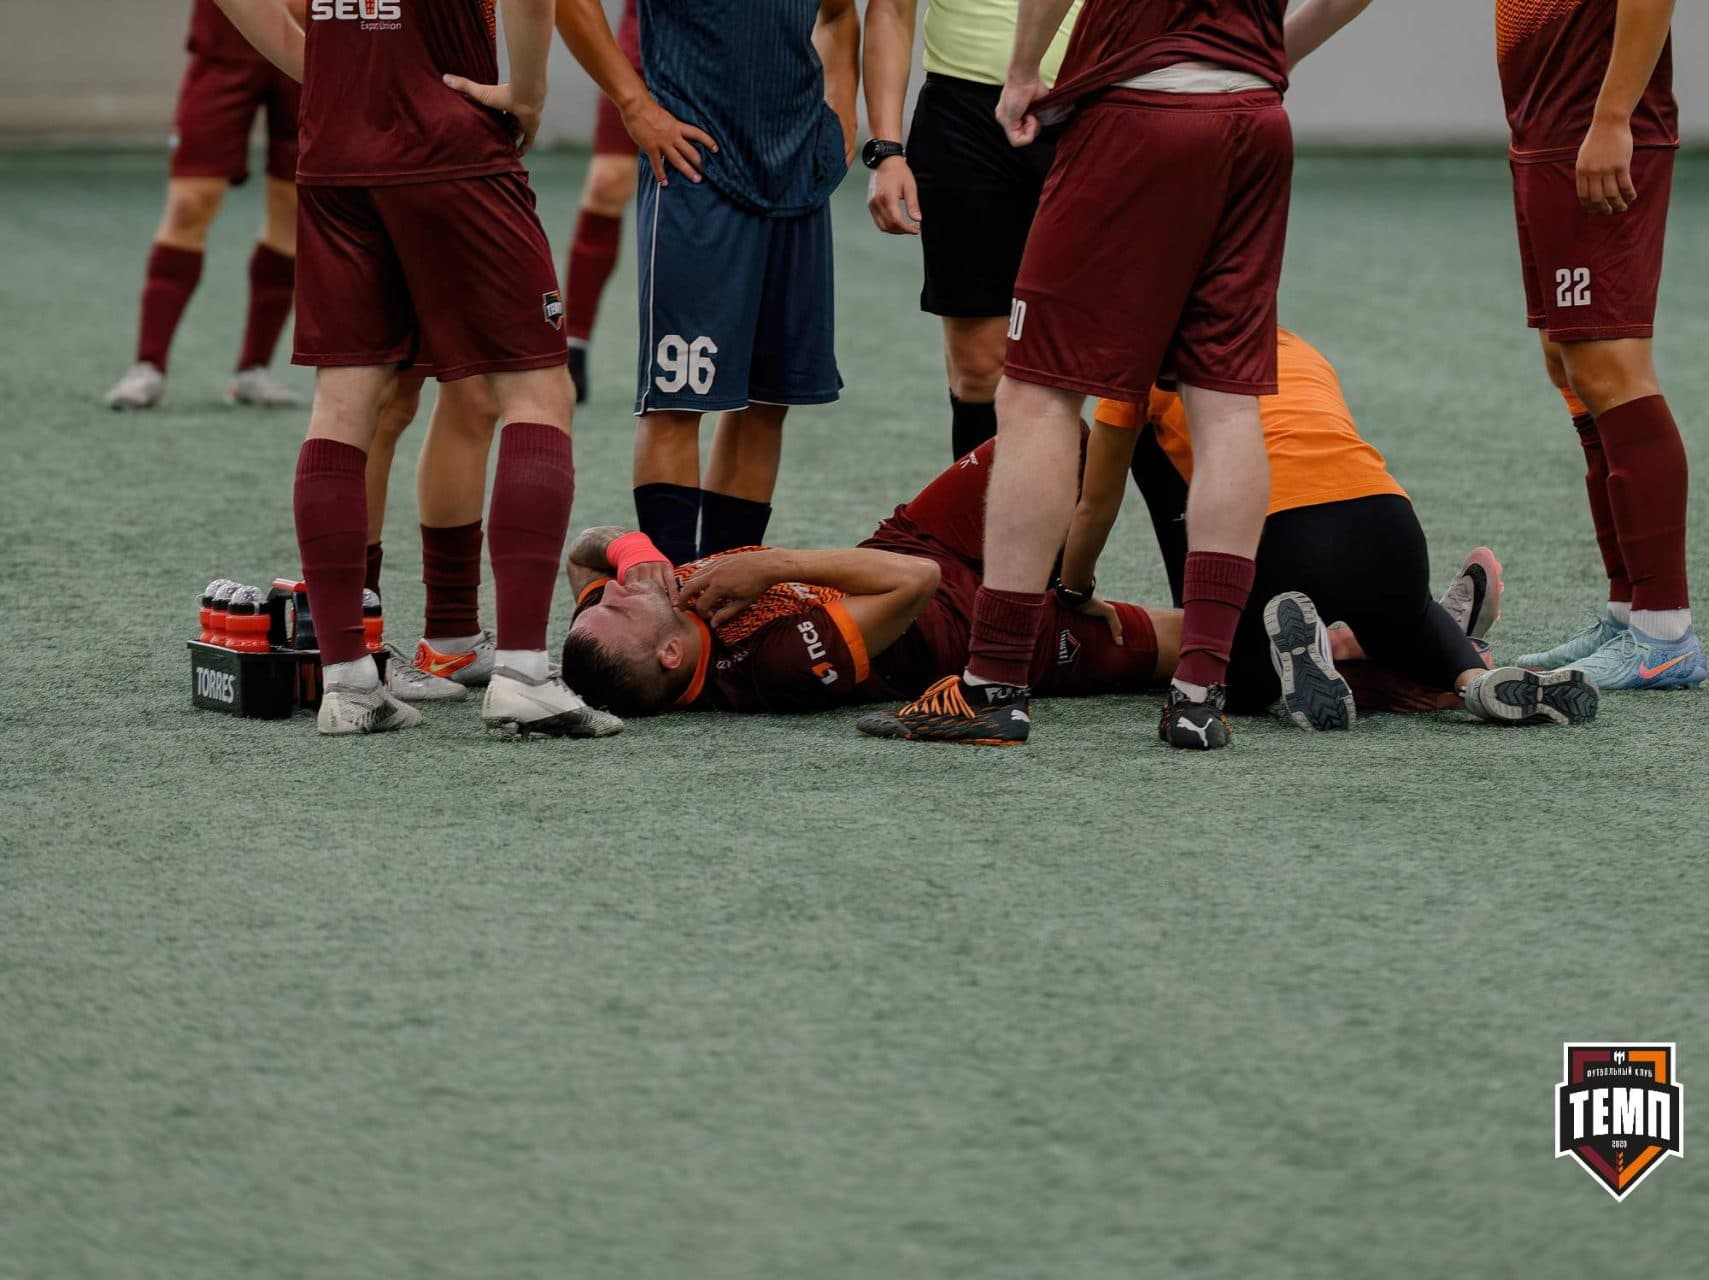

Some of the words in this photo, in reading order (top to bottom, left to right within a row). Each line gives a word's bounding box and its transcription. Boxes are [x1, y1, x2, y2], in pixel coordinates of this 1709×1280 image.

[1556, 267, 1591, 307] 22
[655, 334, 718, 395] 96
[196, 666, 236, 704] TORRES
